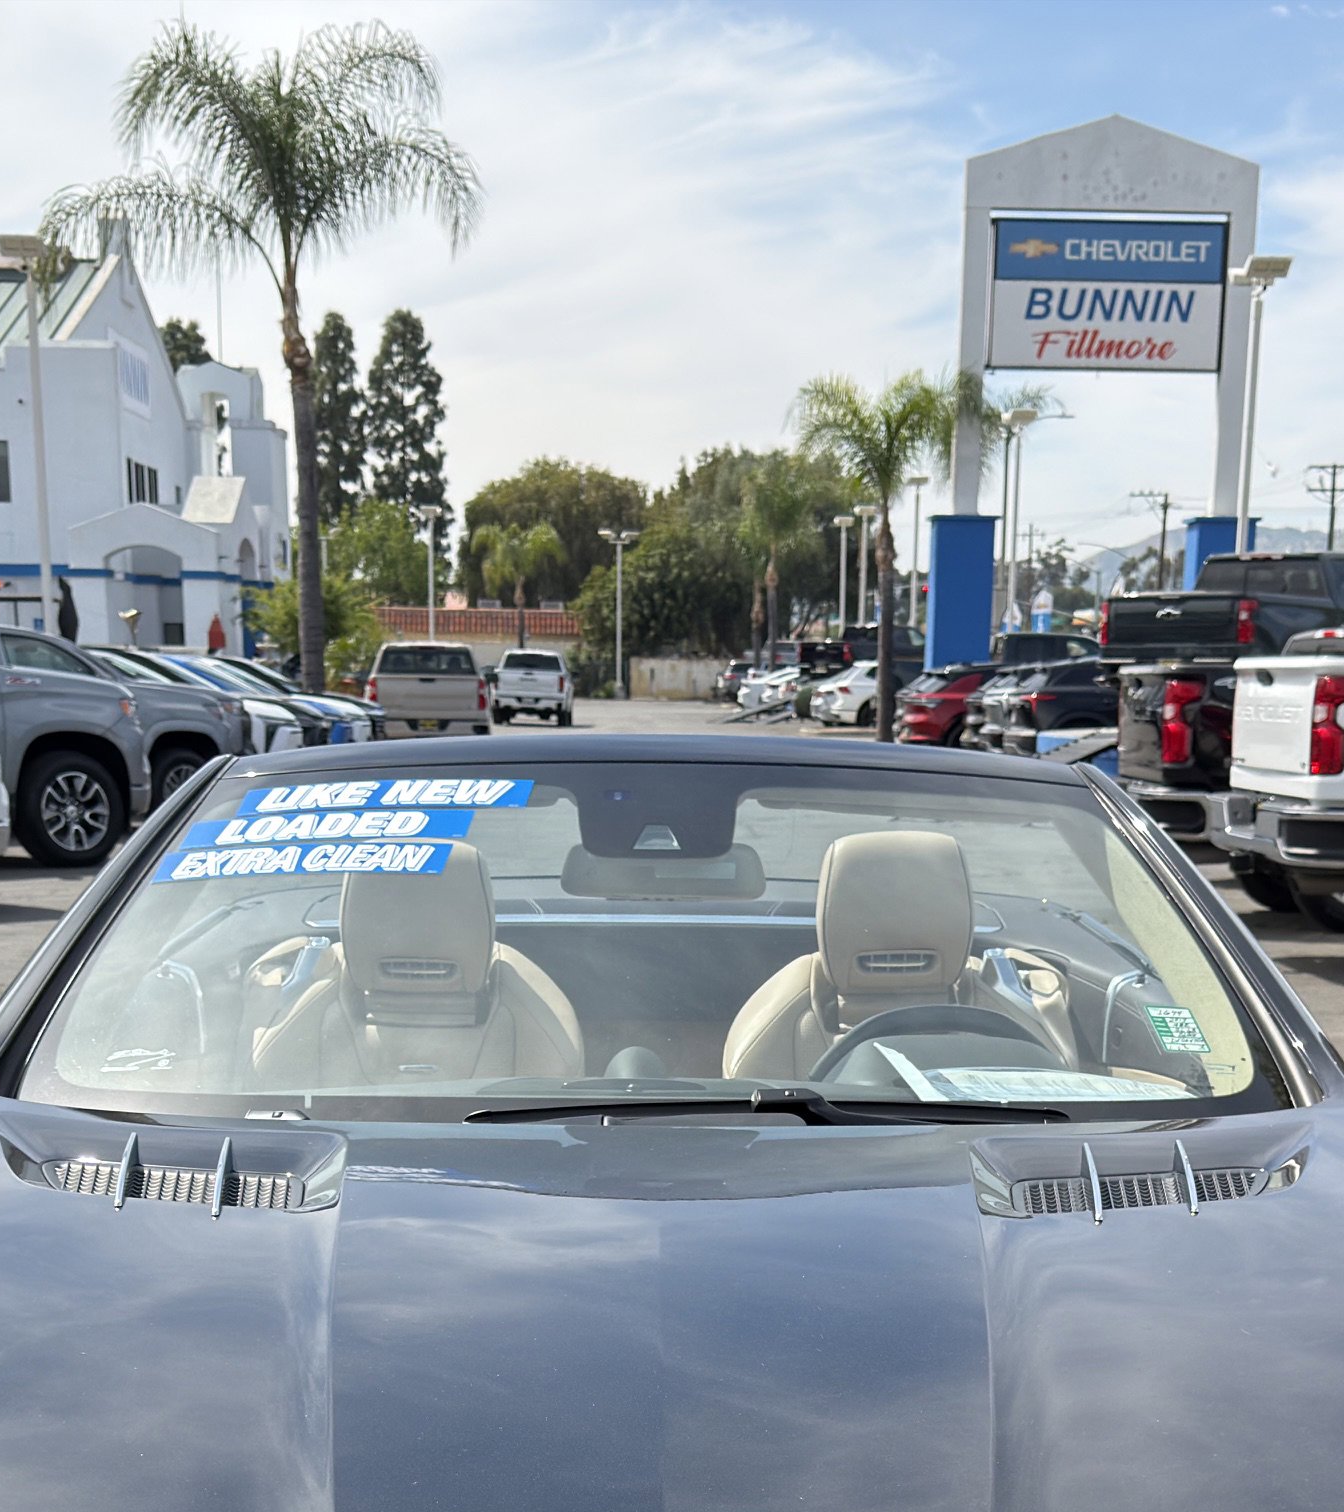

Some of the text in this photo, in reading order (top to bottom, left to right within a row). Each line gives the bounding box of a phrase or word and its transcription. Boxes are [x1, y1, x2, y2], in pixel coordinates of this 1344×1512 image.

[1064, 238, 1211, 263] CHEVROLET
[1024, 287, 1196, 323] BUNNIN
[1031, 328, 1177, 361] Fillmore
[256, 780, 517, 813] LIKE NEW
[215, 811, 430, 846] LOADED
[170, 843, 436, 880] EXTRA CLEAN
